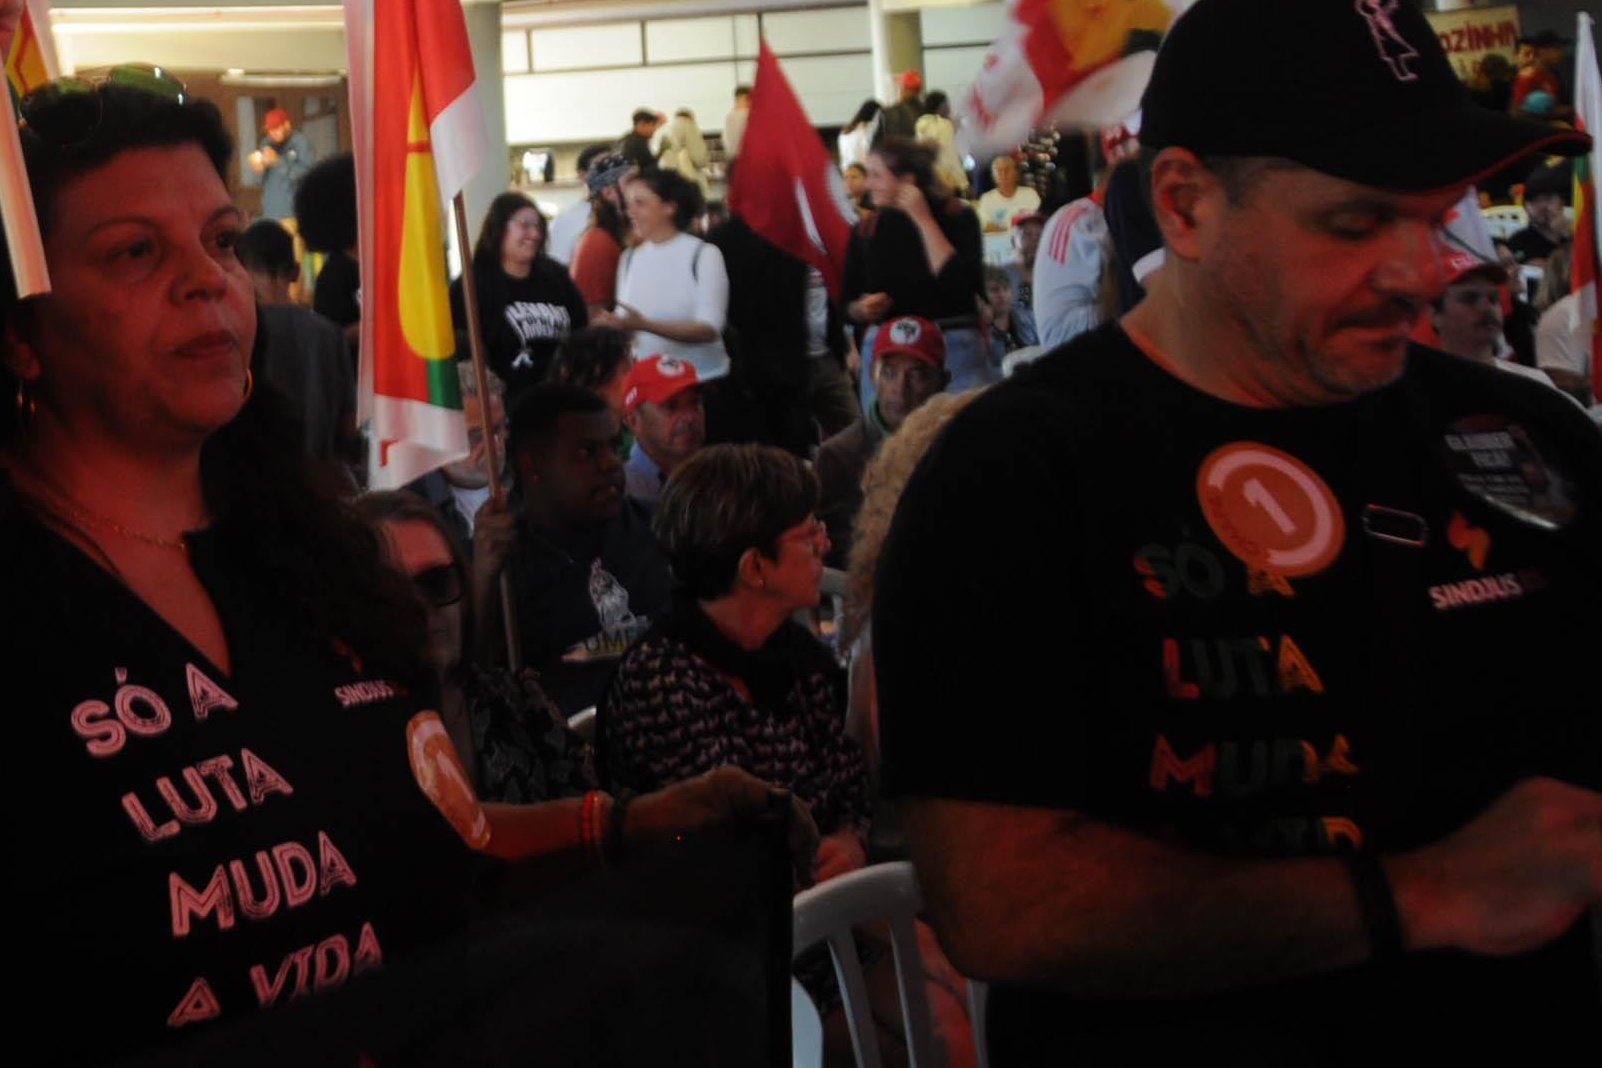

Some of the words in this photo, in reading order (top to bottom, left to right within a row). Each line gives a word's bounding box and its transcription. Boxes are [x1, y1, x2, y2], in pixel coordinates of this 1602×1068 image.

[70, 667, 172, 757] SÓ
[185, 662, 238, 720] A
[1161, 631, 1326, 701] LUTA
[121, 747, 293, 842] LUTA
[168, 830, 357, 939] MUDA
[167, 976, 222, 1027] A
[249, 920, 383, 1006] VIDA
